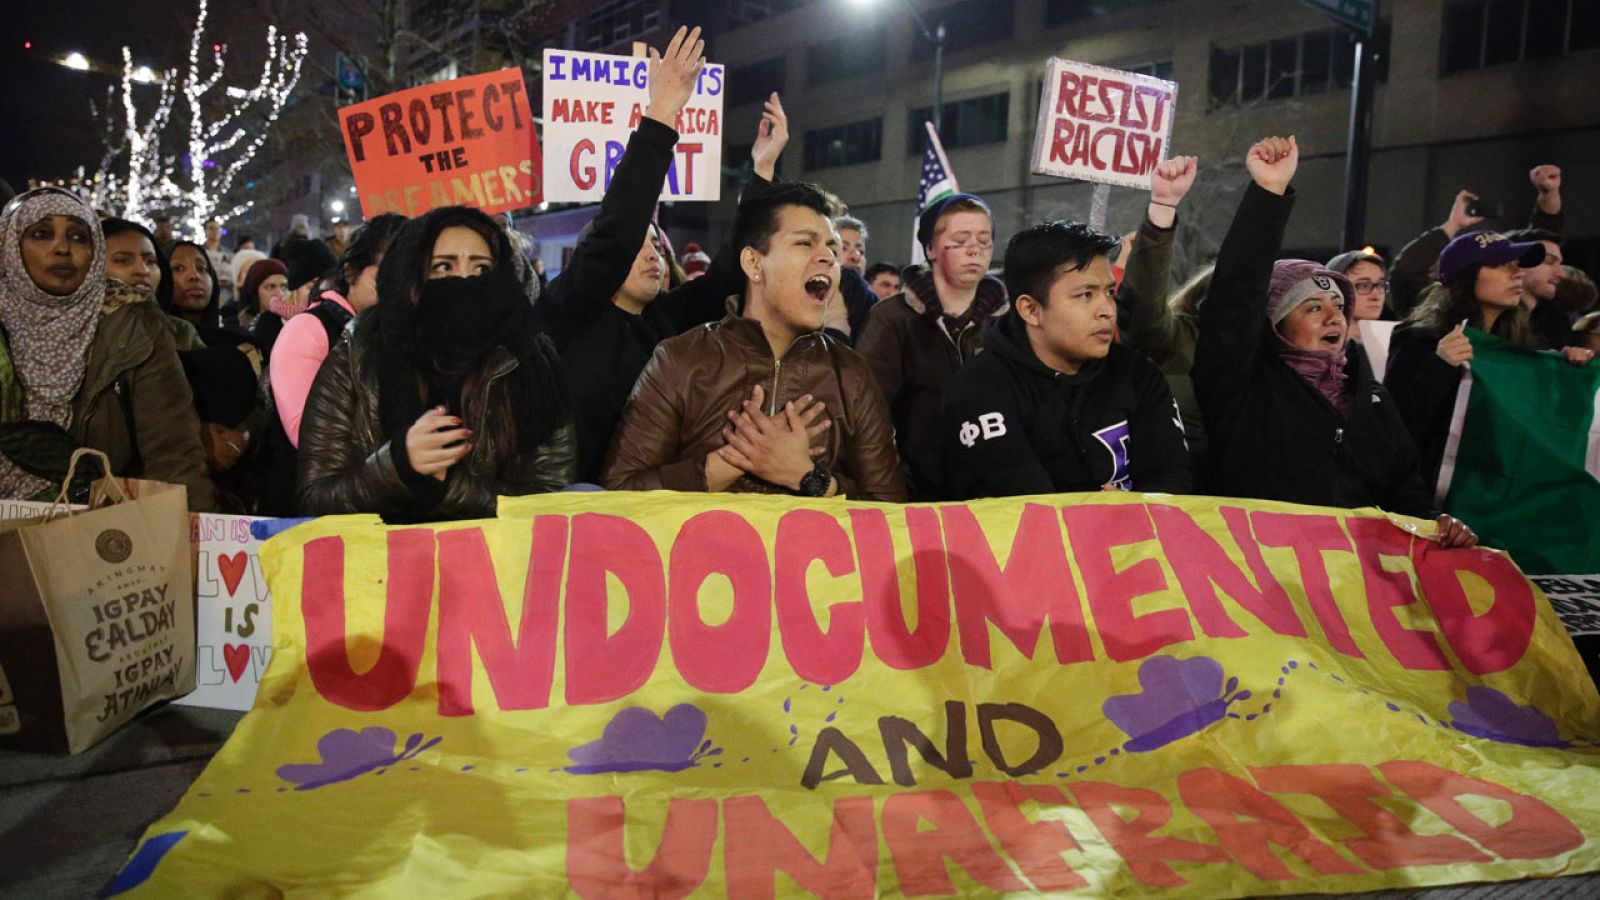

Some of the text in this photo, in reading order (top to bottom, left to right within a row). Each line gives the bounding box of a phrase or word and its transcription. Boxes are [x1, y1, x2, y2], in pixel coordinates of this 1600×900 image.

[549, 55, 723, 96] IMMIGTS
[1056, 71, 1171, 132] RESIST
[346, 79, 523, 162] PROTECT
[551, 98, 719, 136] MAKE ARICA
[419, 147, 469, 173] THE
[1050, 118, 1162, 175] RACISM
[85, 600, 175, 662] EALDAY
[92, 583, 168, 624] IGPAY
[224, 603, 259, 638] IS
[302, 502, 1536, 717] UNDOCUMENTED
[113, 644, 174, 688] IGPAY
[802, 699, 1064, 790] AND
[567, 760, 1586, 900] UNAFRAID
